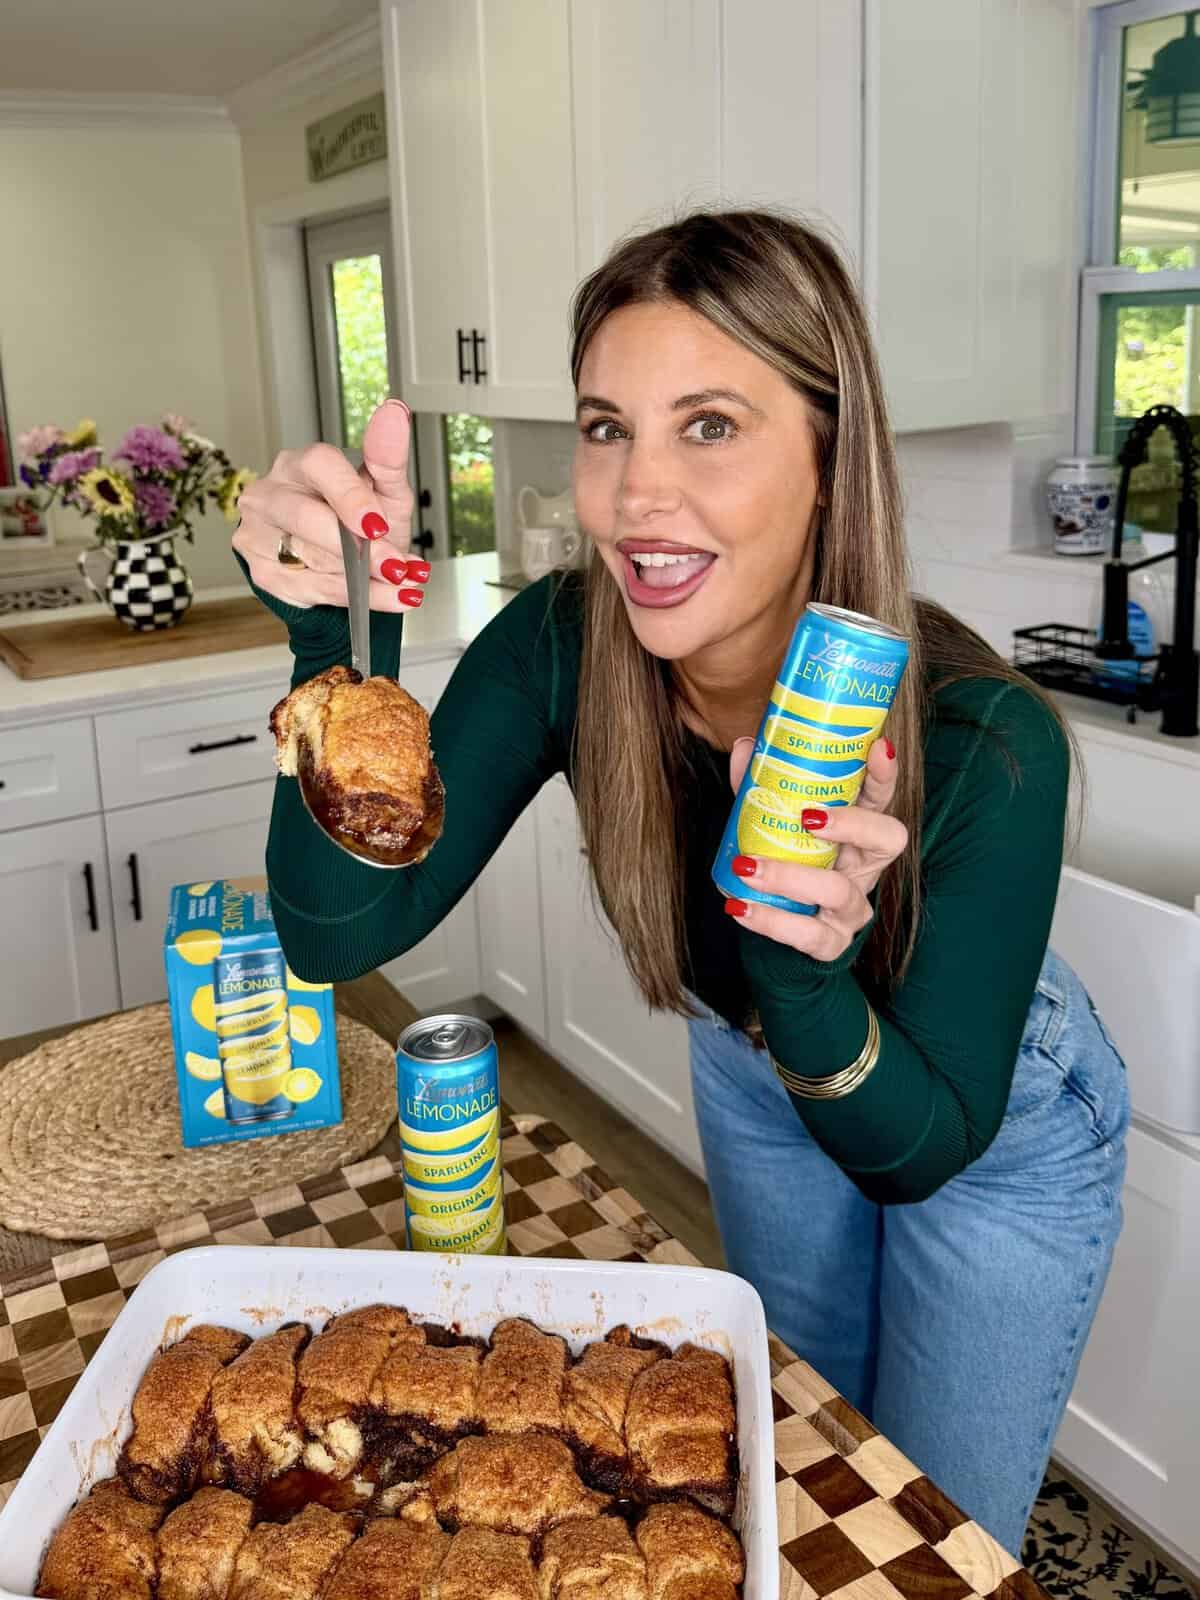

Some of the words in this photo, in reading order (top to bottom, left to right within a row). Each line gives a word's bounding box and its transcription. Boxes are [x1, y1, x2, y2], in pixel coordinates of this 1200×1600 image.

[793, 660, 896, 703] LEMONADE
[787, 735, 864, 755] SPARKLING
[779, 779, 846, 797] ORIGINAL
[761, 814, 808, 834] LEMO
[407, 1088, 495, 1121] LEMONADE
[423, 1147, 488, 1178] SPARKLING
[430, 1188, 487, 1215] ORIGINAL
[429, 1219, 491, 1248] LEMONADE
